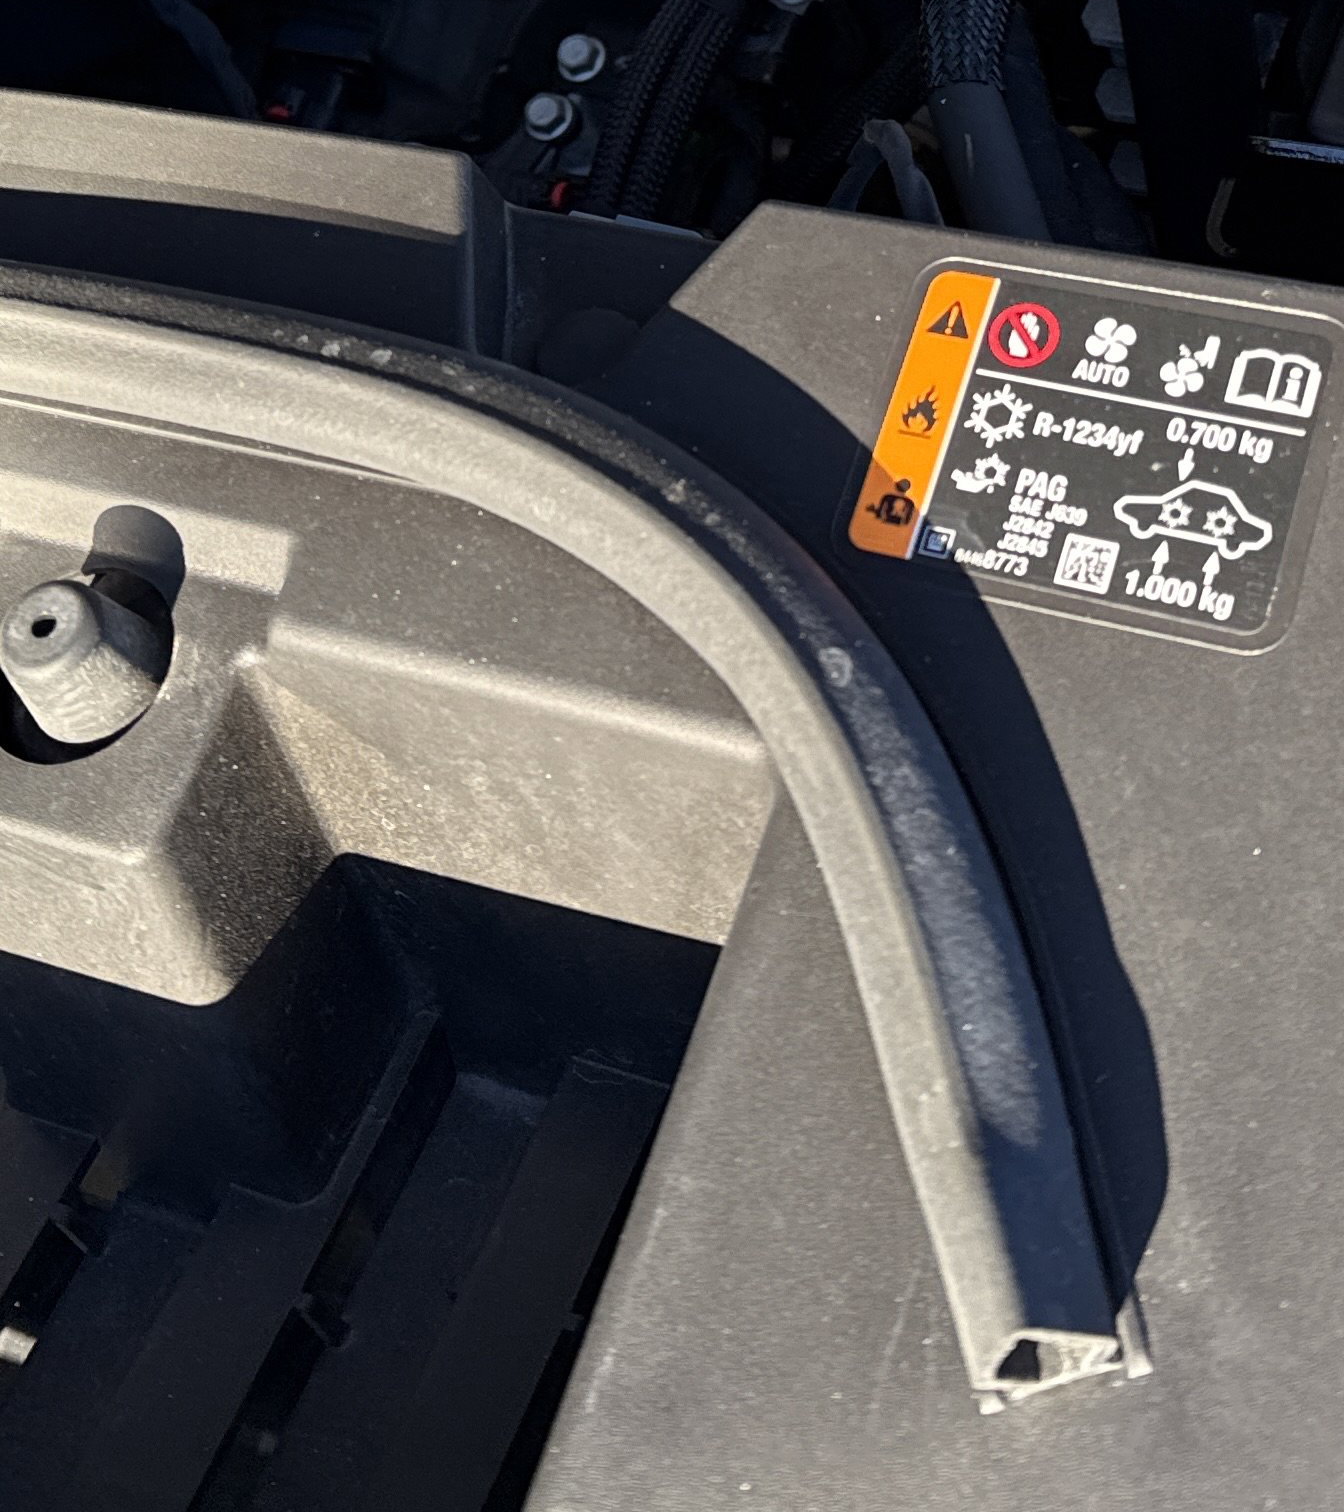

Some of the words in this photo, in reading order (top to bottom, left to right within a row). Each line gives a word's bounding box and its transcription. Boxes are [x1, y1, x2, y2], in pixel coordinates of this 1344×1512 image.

[1071, 359, 1131, 388] AUTO
[1033, 411, 1144, 457] R-1234yf
[1166, 417, 1234, 453] 0.700
[1239, 431, 1274, 464] kg
[1014, 467, 1068, 502] PAG
[1008, 494, 1044, 517] SAE
[1124, 569, 1198, 609] 1.000
[1198, 585, 1235, 621] kg
